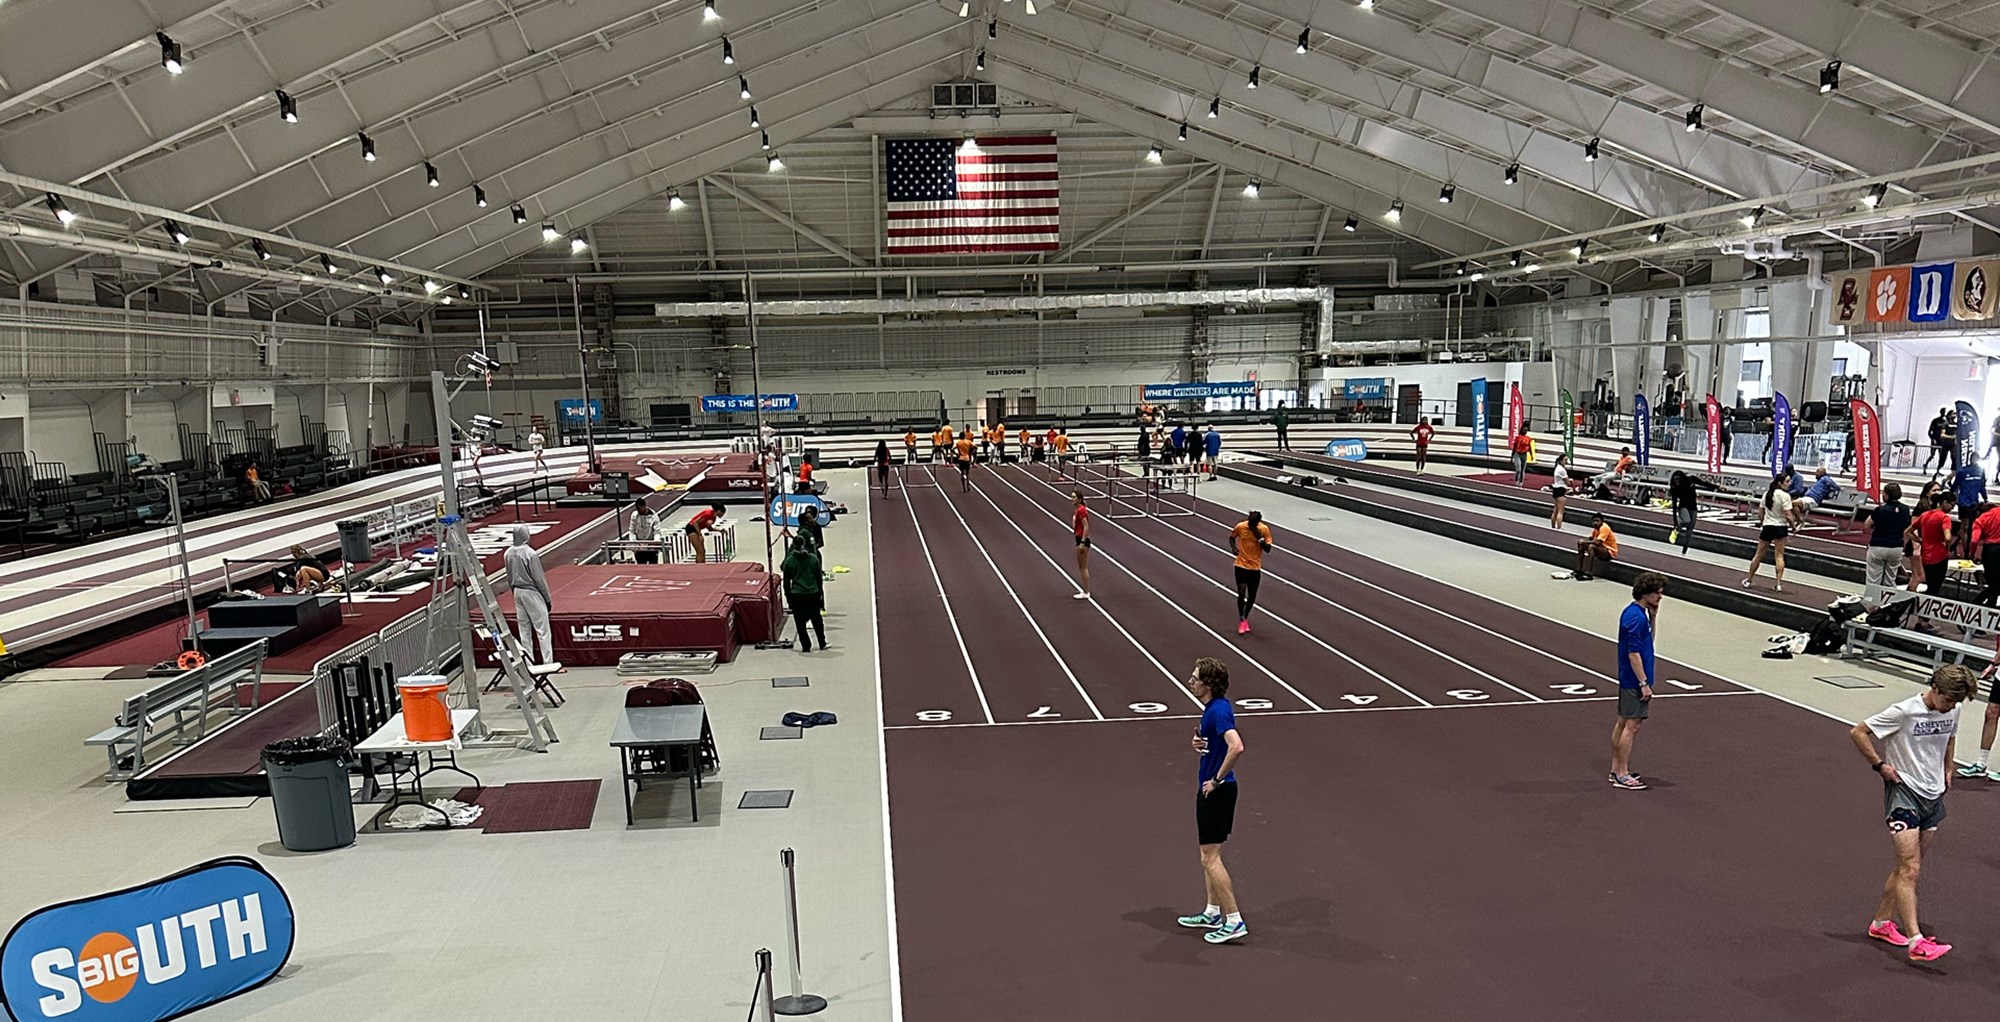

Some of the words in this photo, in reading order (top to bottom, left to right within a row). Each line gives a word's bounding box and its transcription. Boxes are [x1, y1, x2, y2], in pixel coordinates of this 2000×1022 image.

[1145, 389, 1172, 398] WHERE
[1174, 388, 1211, 397] WINNERS
[1212, 387, 1229, 395] ARE
[1231, 386, 1255, 395] MADE
[1348, 384, 1380, 395] SOUTH
[707, 399, 726, 408] THIS
[728, 399, 736, 408] IS
[738, 399, 755, 408] THE
[1332, 444, 1364, 457] SOUTH
[1722, 476, 1741, 487] TECH
[1881, 590, 1896, 605] VT
[1916, 596, 1981, 626] VIRGINIA
[570, 625, 622, 637] UCS
[1550, 683, 1597, 695] 2
[1666, 680, 1704, 691] 1
[1341, 694, 1379, 706] 4
[1446, 690, 1490, 701] 3
[1129, 702, 1168, 713] 6
[1235, 698, 1272, 710] 5
[916, 709, 952, 721] 8
[1027, 706, 1061, 718] 7
[78, 946, 139, 989] BIG
